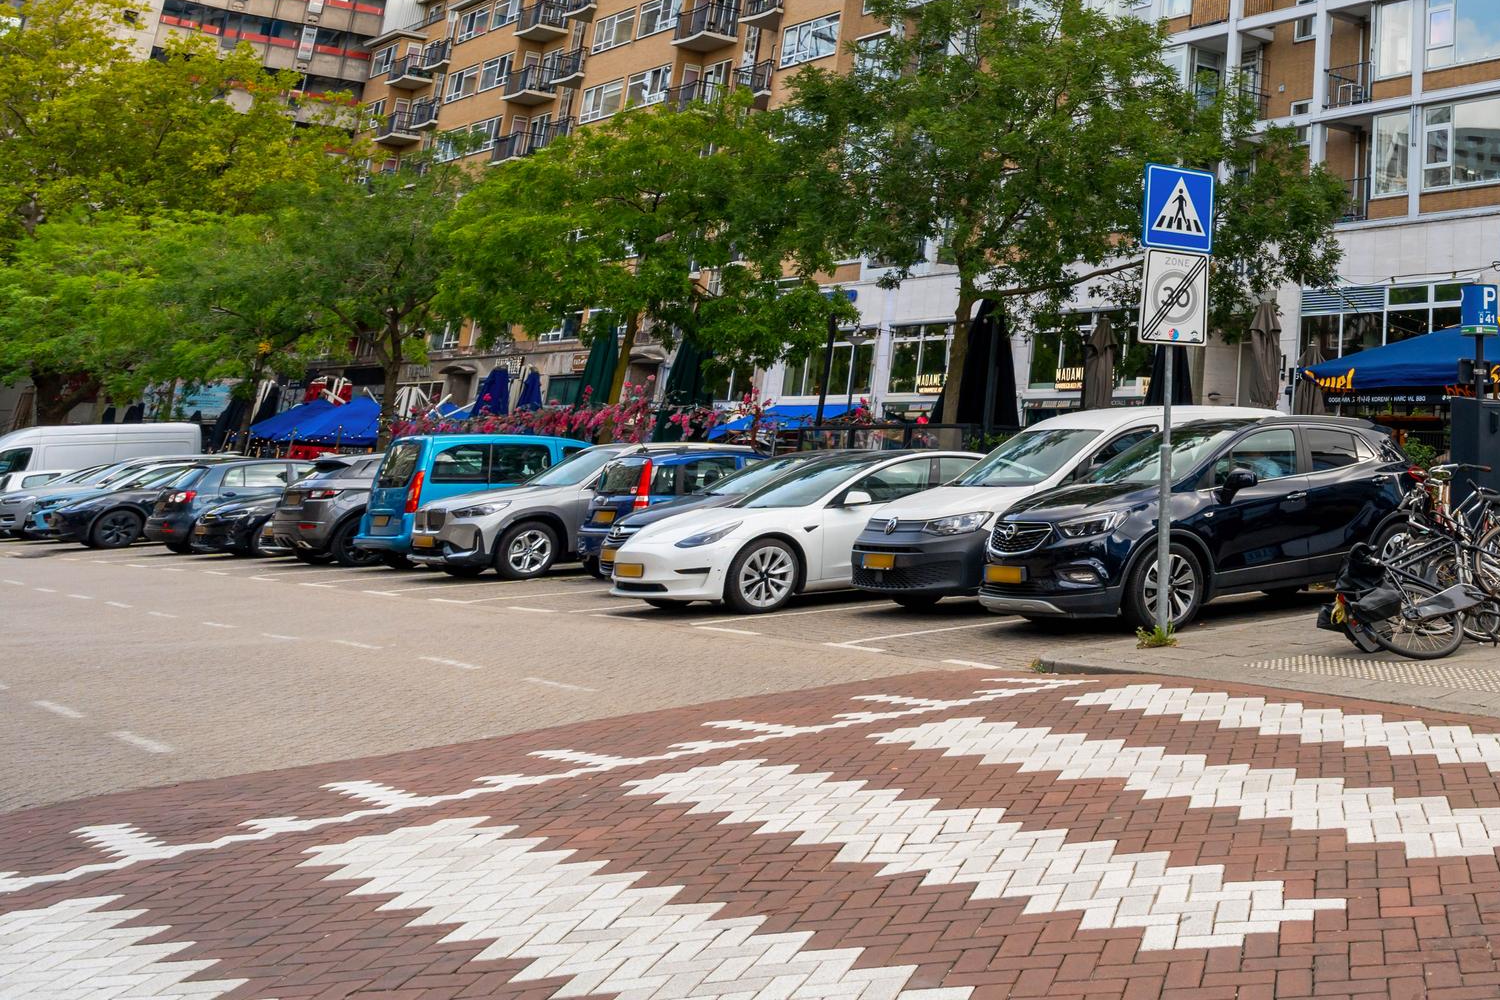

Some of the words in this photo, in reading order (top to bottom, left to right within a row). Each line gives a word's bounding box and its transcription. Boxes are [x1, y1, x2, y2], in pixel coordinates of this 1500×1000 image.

[1165, 256, 1190, 267] ZONE
[1161, 286, 1190, 308] 30
[1483, 287, 1496, 309] P
[1485, 314, 1495, 323] 41
